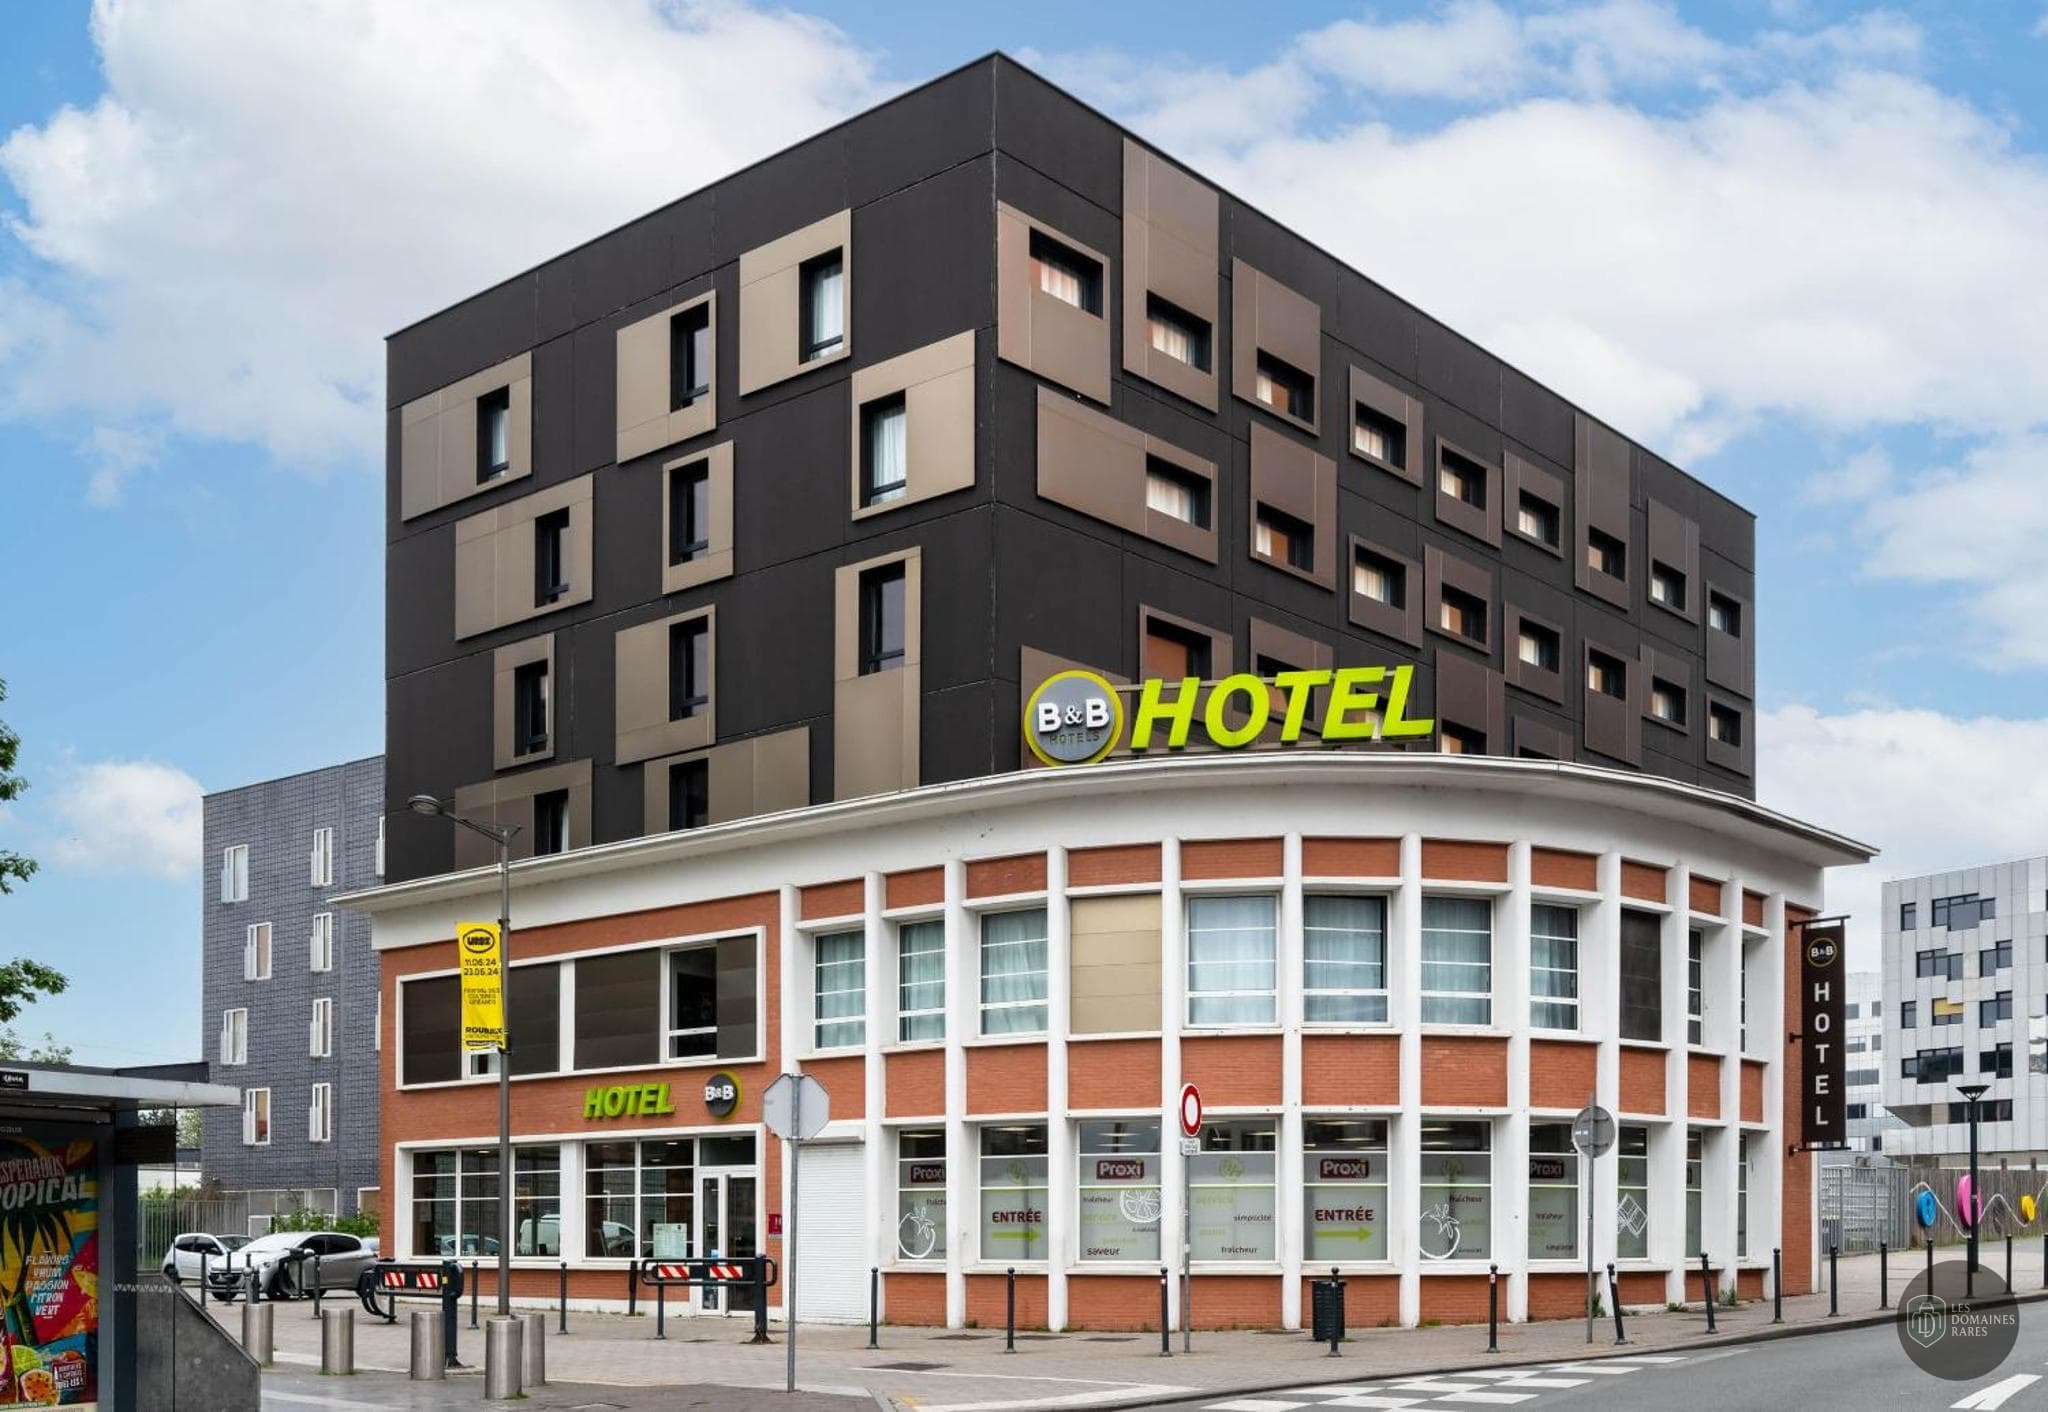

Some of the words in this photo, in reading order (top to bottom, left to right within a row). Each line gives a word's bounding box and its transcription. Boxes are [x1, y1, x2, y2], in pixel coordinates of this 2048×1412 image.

[1038, 698, 1110, 732] B&B
[1130, 665, 1435, 751] HOTEL
[1049, 731, 1101, 744] HOTELS
[1811, 945, 1834, 958] B&B
[1813, 981, 1831, 1126] HOTEL
[583, 1081, 676, 1119] HOTEL
[704, 1085, 734, 1101] B&B
[1099, 1158, 1142, 1176] Proxi
[1321, 1158, 1368, 1176] Proxi
[1530, 1160, 1563, 1176] Proxi
[0, 1172, 94, 1210] OPICAL
[991, 1207, 1042, 1224] ENTRÉE
[1314, 1206, 1375, 1222] ENTRÉE
[1086, 1246, 1121, 1256] saveur
[35, 1304, 61, 1316] VERT
